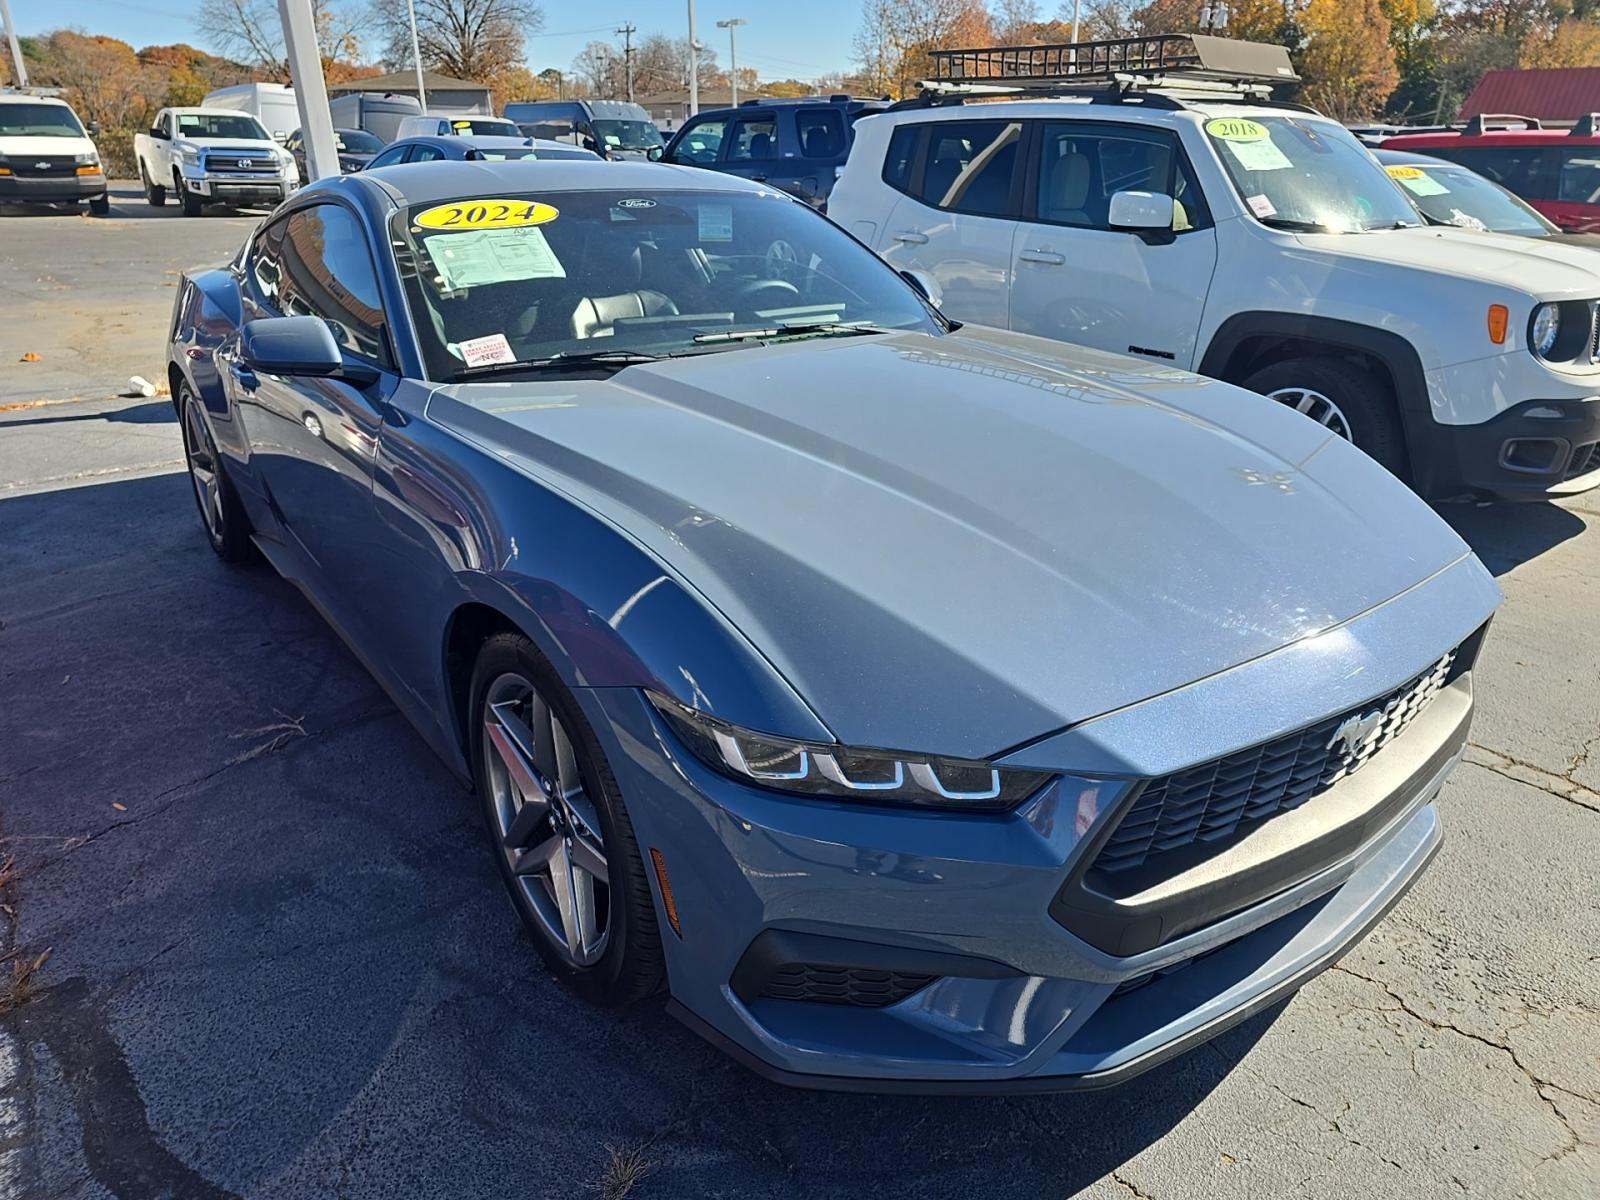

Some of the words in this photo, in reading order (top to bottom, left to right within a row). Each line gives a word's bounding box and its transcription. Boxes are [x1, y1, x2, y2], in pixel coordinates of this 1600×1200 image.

[1220, 123, 1258, 136] 2018
[624, 199, 654, 208] Ford
[442, 204, 536, 226] 2024
